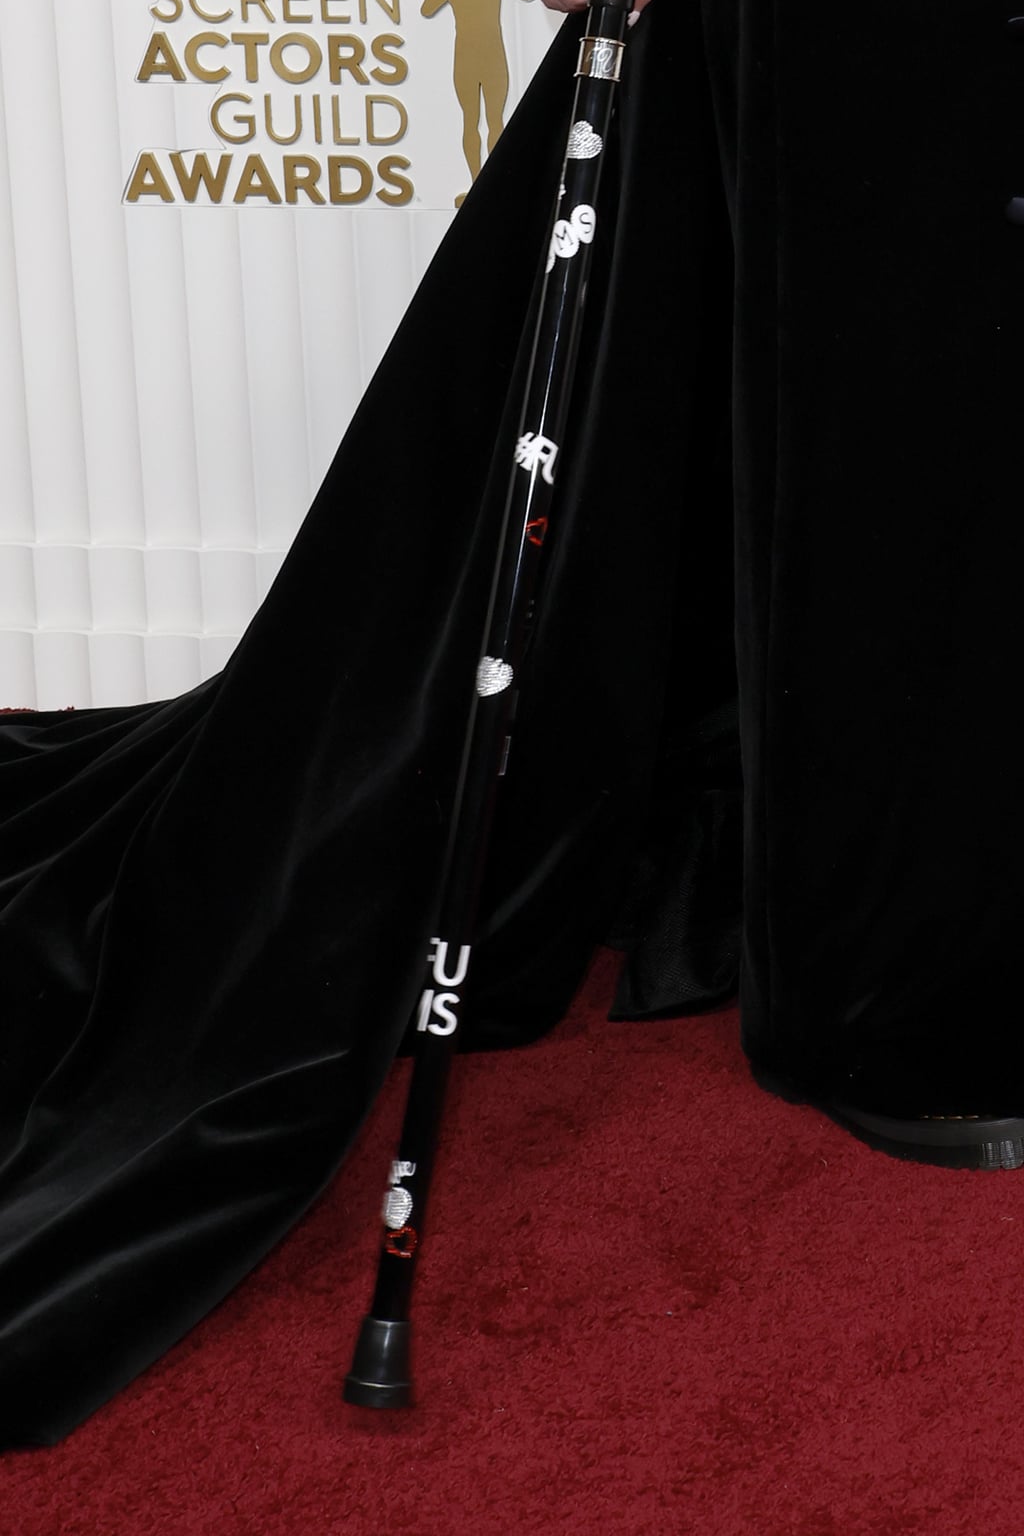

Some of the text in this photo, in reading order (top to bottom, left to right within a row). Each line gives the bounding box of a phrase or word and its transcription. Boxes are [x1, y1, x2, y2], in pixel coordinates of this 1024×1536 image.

[137, 31, 408, 85] ACTORS
[210, 92, 408, 145] GUILD
[126, 151, 414, 205] AWARDS
